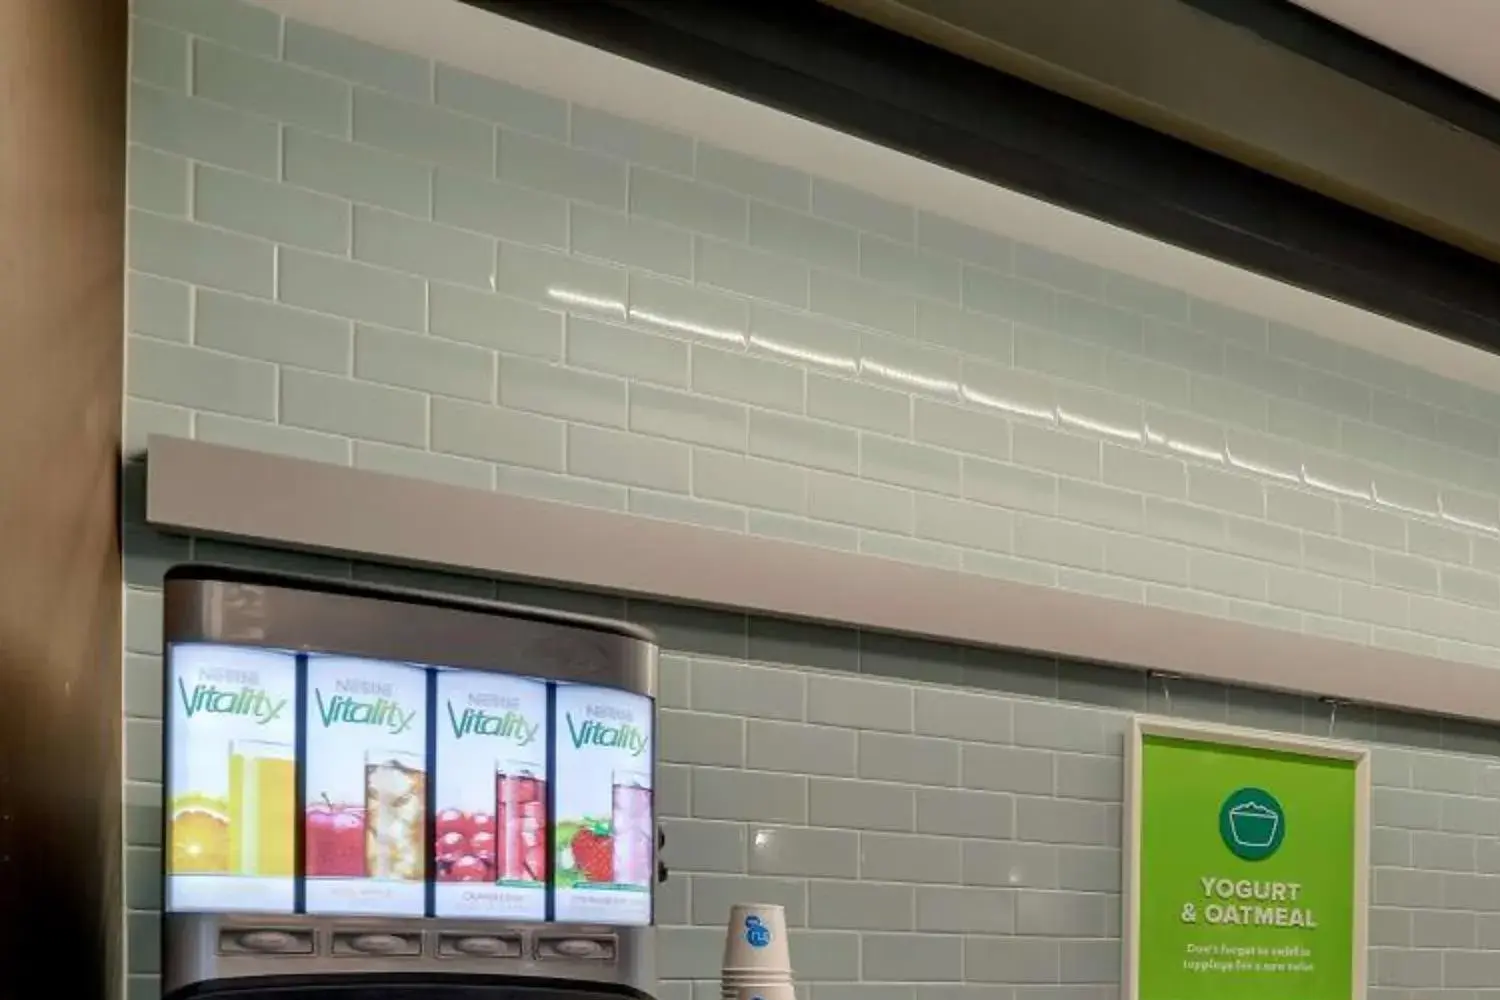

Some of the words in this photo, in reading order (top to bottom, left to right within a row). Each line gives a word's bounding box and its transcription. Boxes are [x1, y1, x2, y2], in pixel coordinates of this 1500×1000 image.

[178, 675, 289, 725] Vitality
[314, 687, 417, 735] Vitality
[447, 698, 540, 747] Vitality
[565, 710, 649, 757] Vitality
[1200, 877, 1302, 901] YOGURT
[1181, 903, 1197, 923] &
[1205, 904, 1319, 928] OATMEAL
